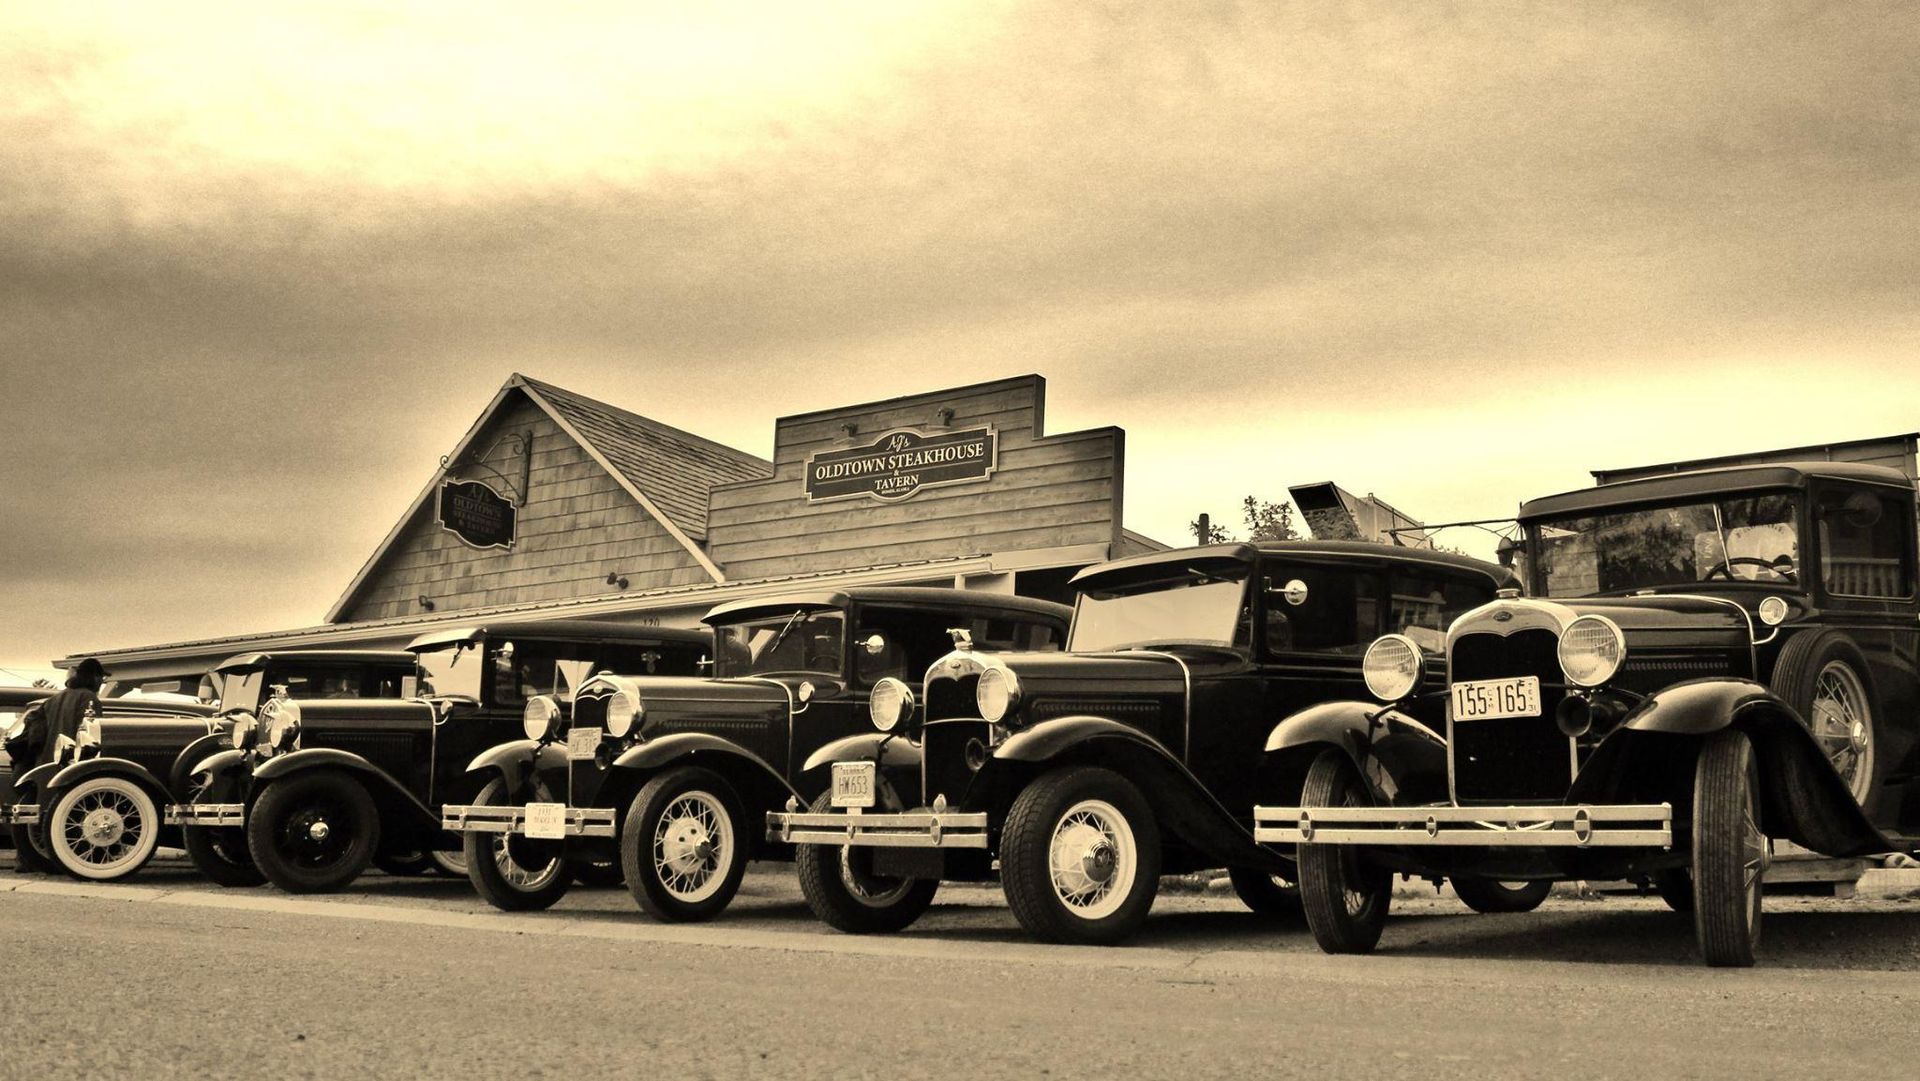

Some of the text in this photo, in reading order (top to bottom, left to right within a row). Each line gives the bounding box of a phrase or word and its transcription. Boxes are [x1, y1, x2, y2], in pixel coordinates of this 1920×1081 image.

[815, 443, 984, 480] OLDTOWN STEAKHOUSE
[874, 474, 919, 490] TAVERN
[1458, 680, 1526, 716] 155 165
